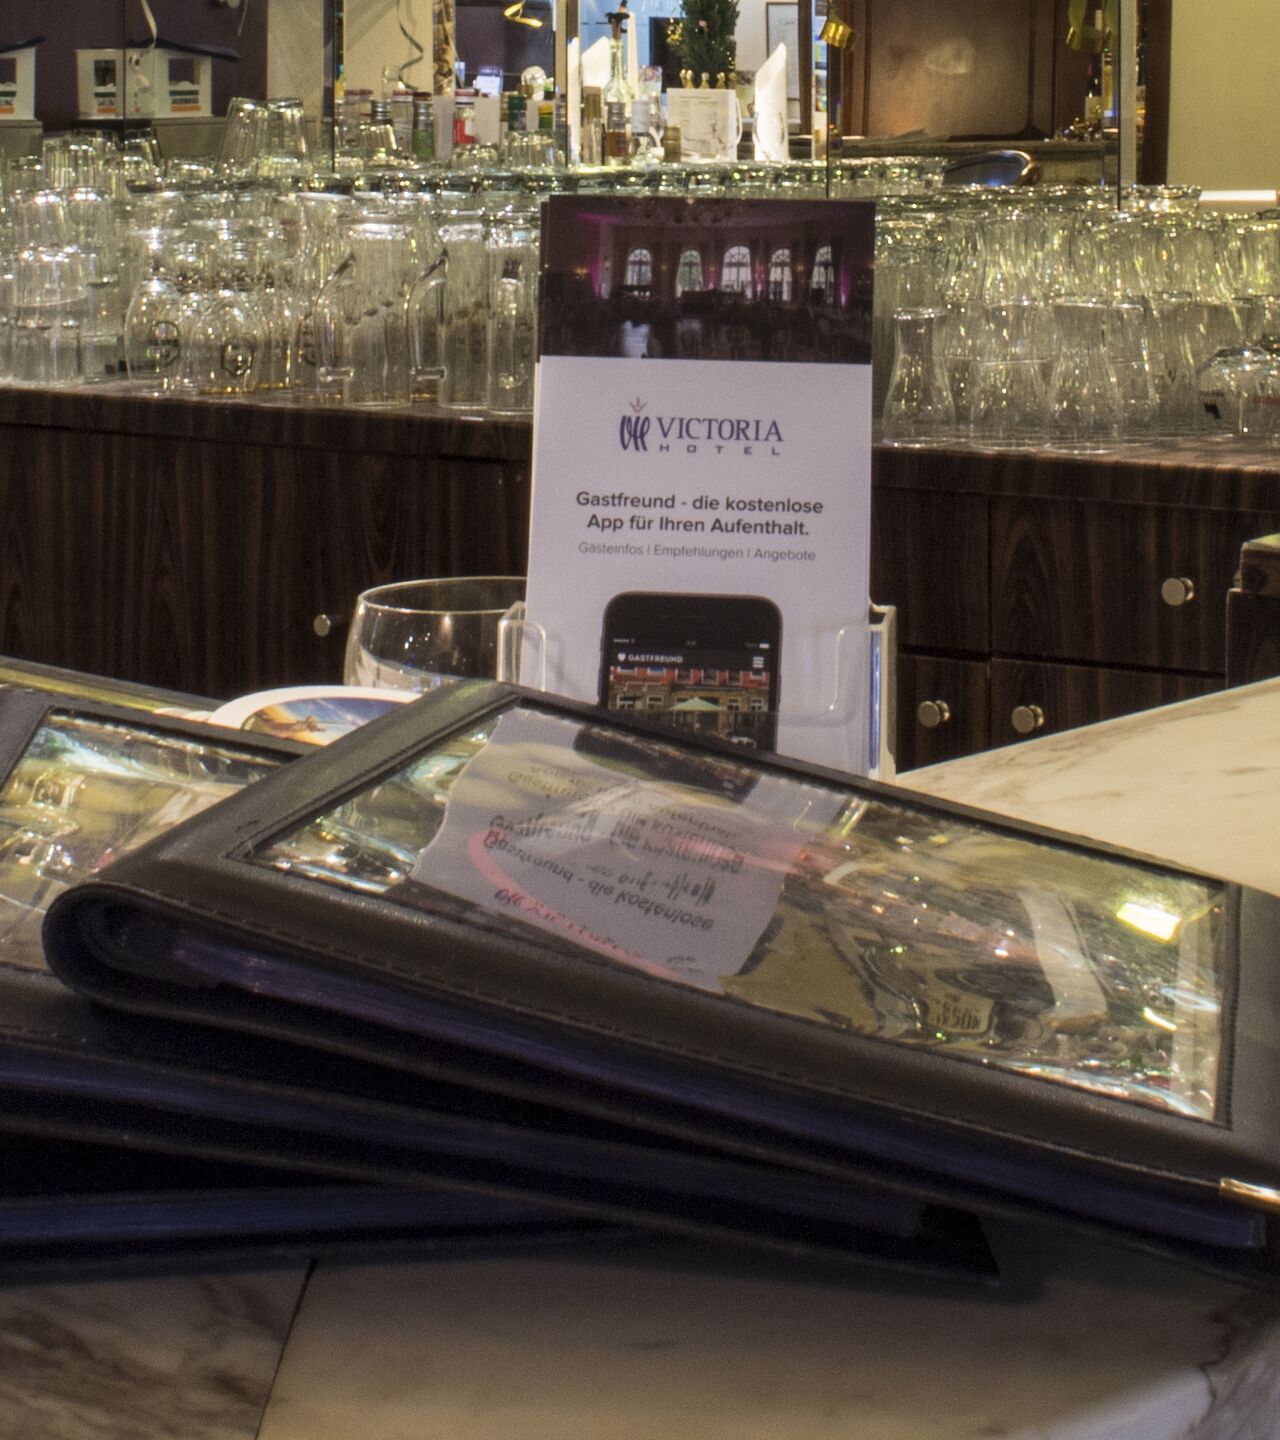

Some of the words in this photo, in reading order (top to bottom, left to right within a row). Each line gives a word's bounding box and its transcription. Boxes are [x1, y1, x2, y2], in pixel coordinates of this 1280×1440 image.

[656, 416, 784, 442] VICTORIA
[659, 444, 781, 456] HOTEL
[576, 491, 675, 509] Gastfreund
[692, 495, 720, 510] die
[726, 496, 824, 514] kostenlose
[587, 513, 624, 533] App
[629, 514, 654, 530] für
[659, 516, 705, 532] Ihren
[710, 518, 810, 536] Aufenthalt.
[578, 541, 644, 556] Gästeinfos
[653, 544, 744, 561] Empfehlungen
[754, 547, 816, 563] Angebote
[628, 653, 683, 663] GASTFREUND
